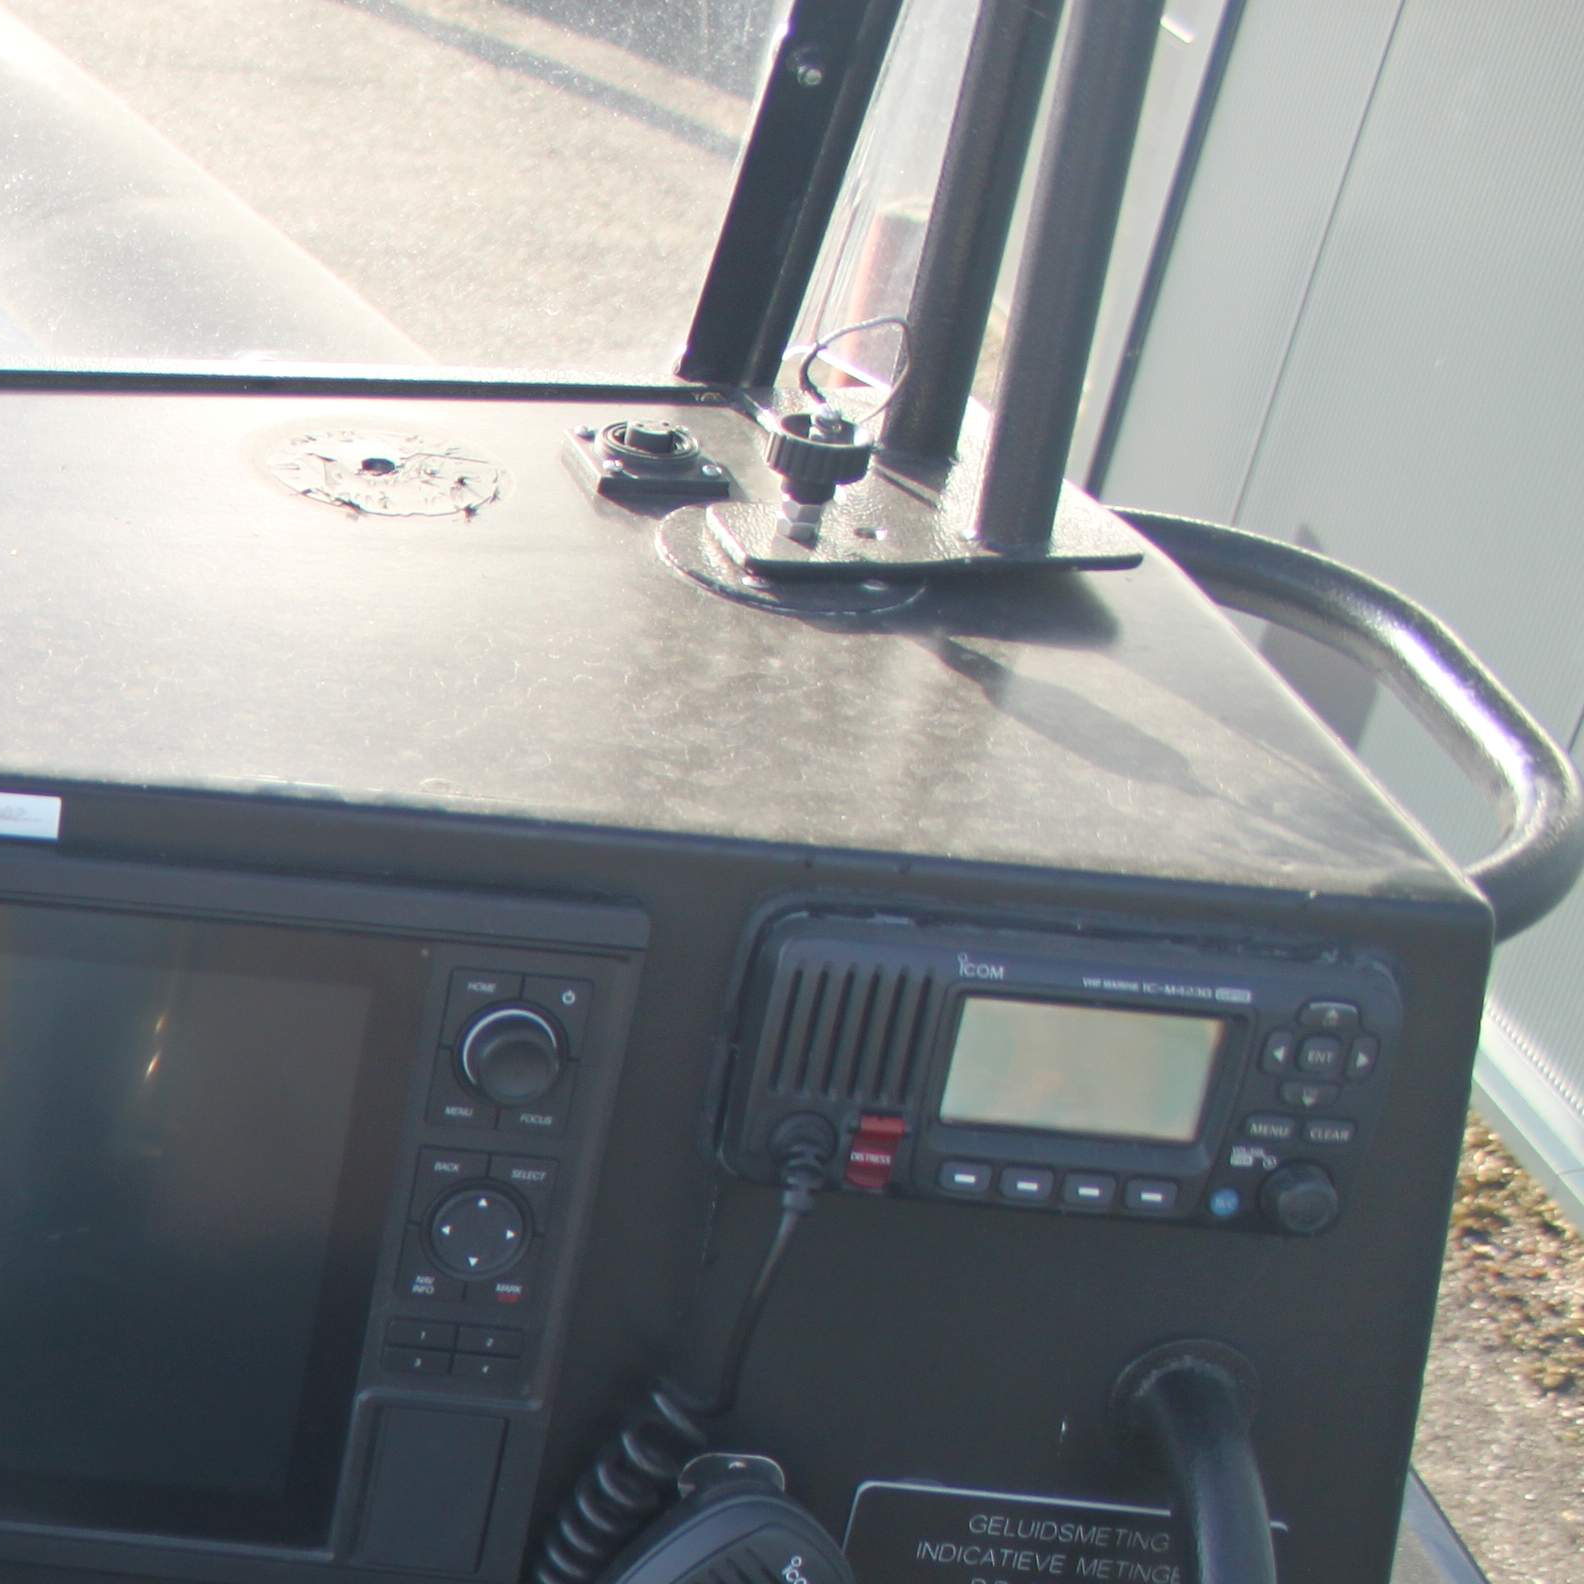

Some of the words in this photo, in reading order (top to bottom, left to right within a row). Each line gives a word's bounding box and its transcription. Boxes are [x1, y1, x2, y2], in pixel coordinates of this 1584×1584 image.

[1304, 1050, 1333, 1064] ENT
[443, 1105, 474, 1117] MENU
[519, 1112, 553, 1126] FOCUS
[1248, 1124, 1289, 1138] MENU
[1309, 1128, 1351, 1142] CLEAR
[850, 1151, 891, 1166] DISTRESS
[433, 1161, 462, 1174] BACK
[511, 1168, 547, 1182] SELECT
[968, 1514, 1171, 1553] GELUIDSMETING
[916, 1541, 1067, 1576] INDICATIEVE
